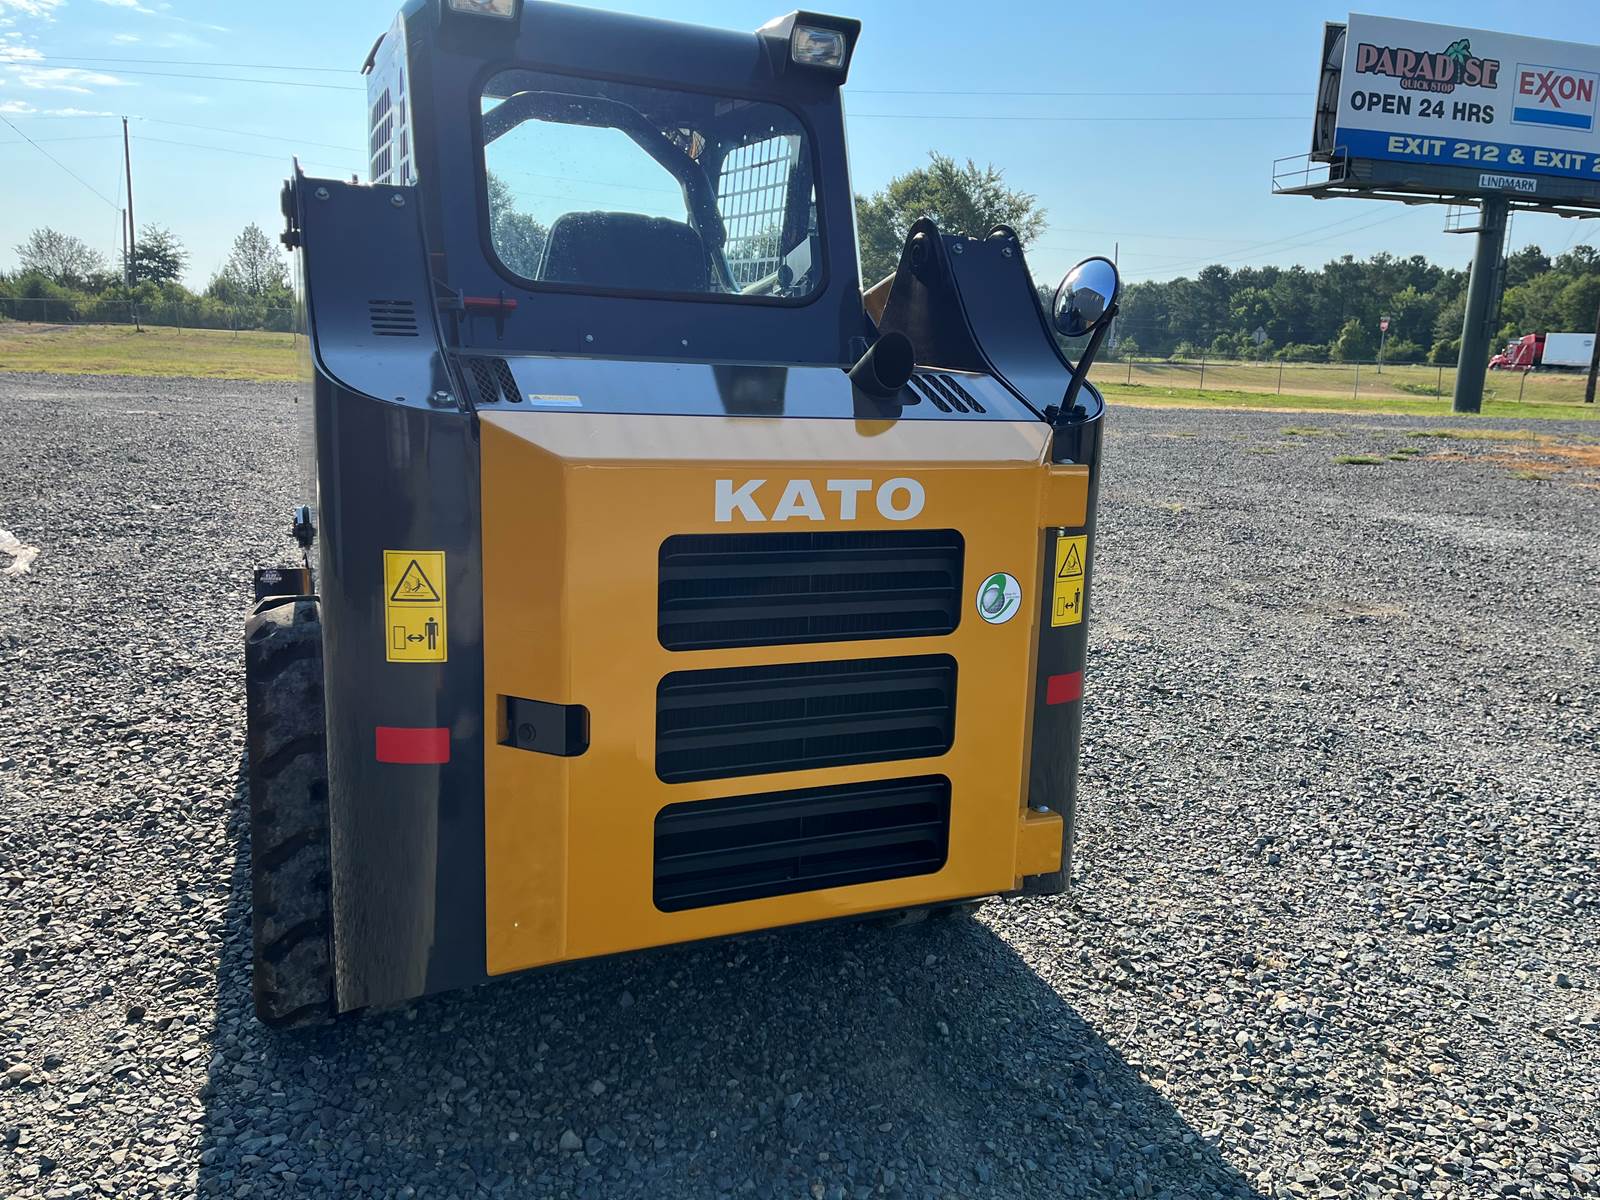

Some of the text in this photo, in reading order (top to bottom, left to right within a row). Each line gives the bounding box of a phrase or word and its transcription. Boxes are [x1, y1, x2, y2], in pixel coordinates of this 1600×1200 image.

[1356, 43, 1500, 89] PARADISE
[1401, 78, 1455, 94] QUICK STOP
[1519, 71, 1594, 108] EXXON
[1350, 91, 1495, 125] OPEN 24 HRS
[1388, 136, 1446, 157] EXIT
[1453, 143, 1500, 163] 212
[1507, 148, 1526, 165] &
[1533, 150, 1587, 171] EXIT
[1481, 175, 1536, 192] LINDMARK
[714, 477, 926, 522] KATO
